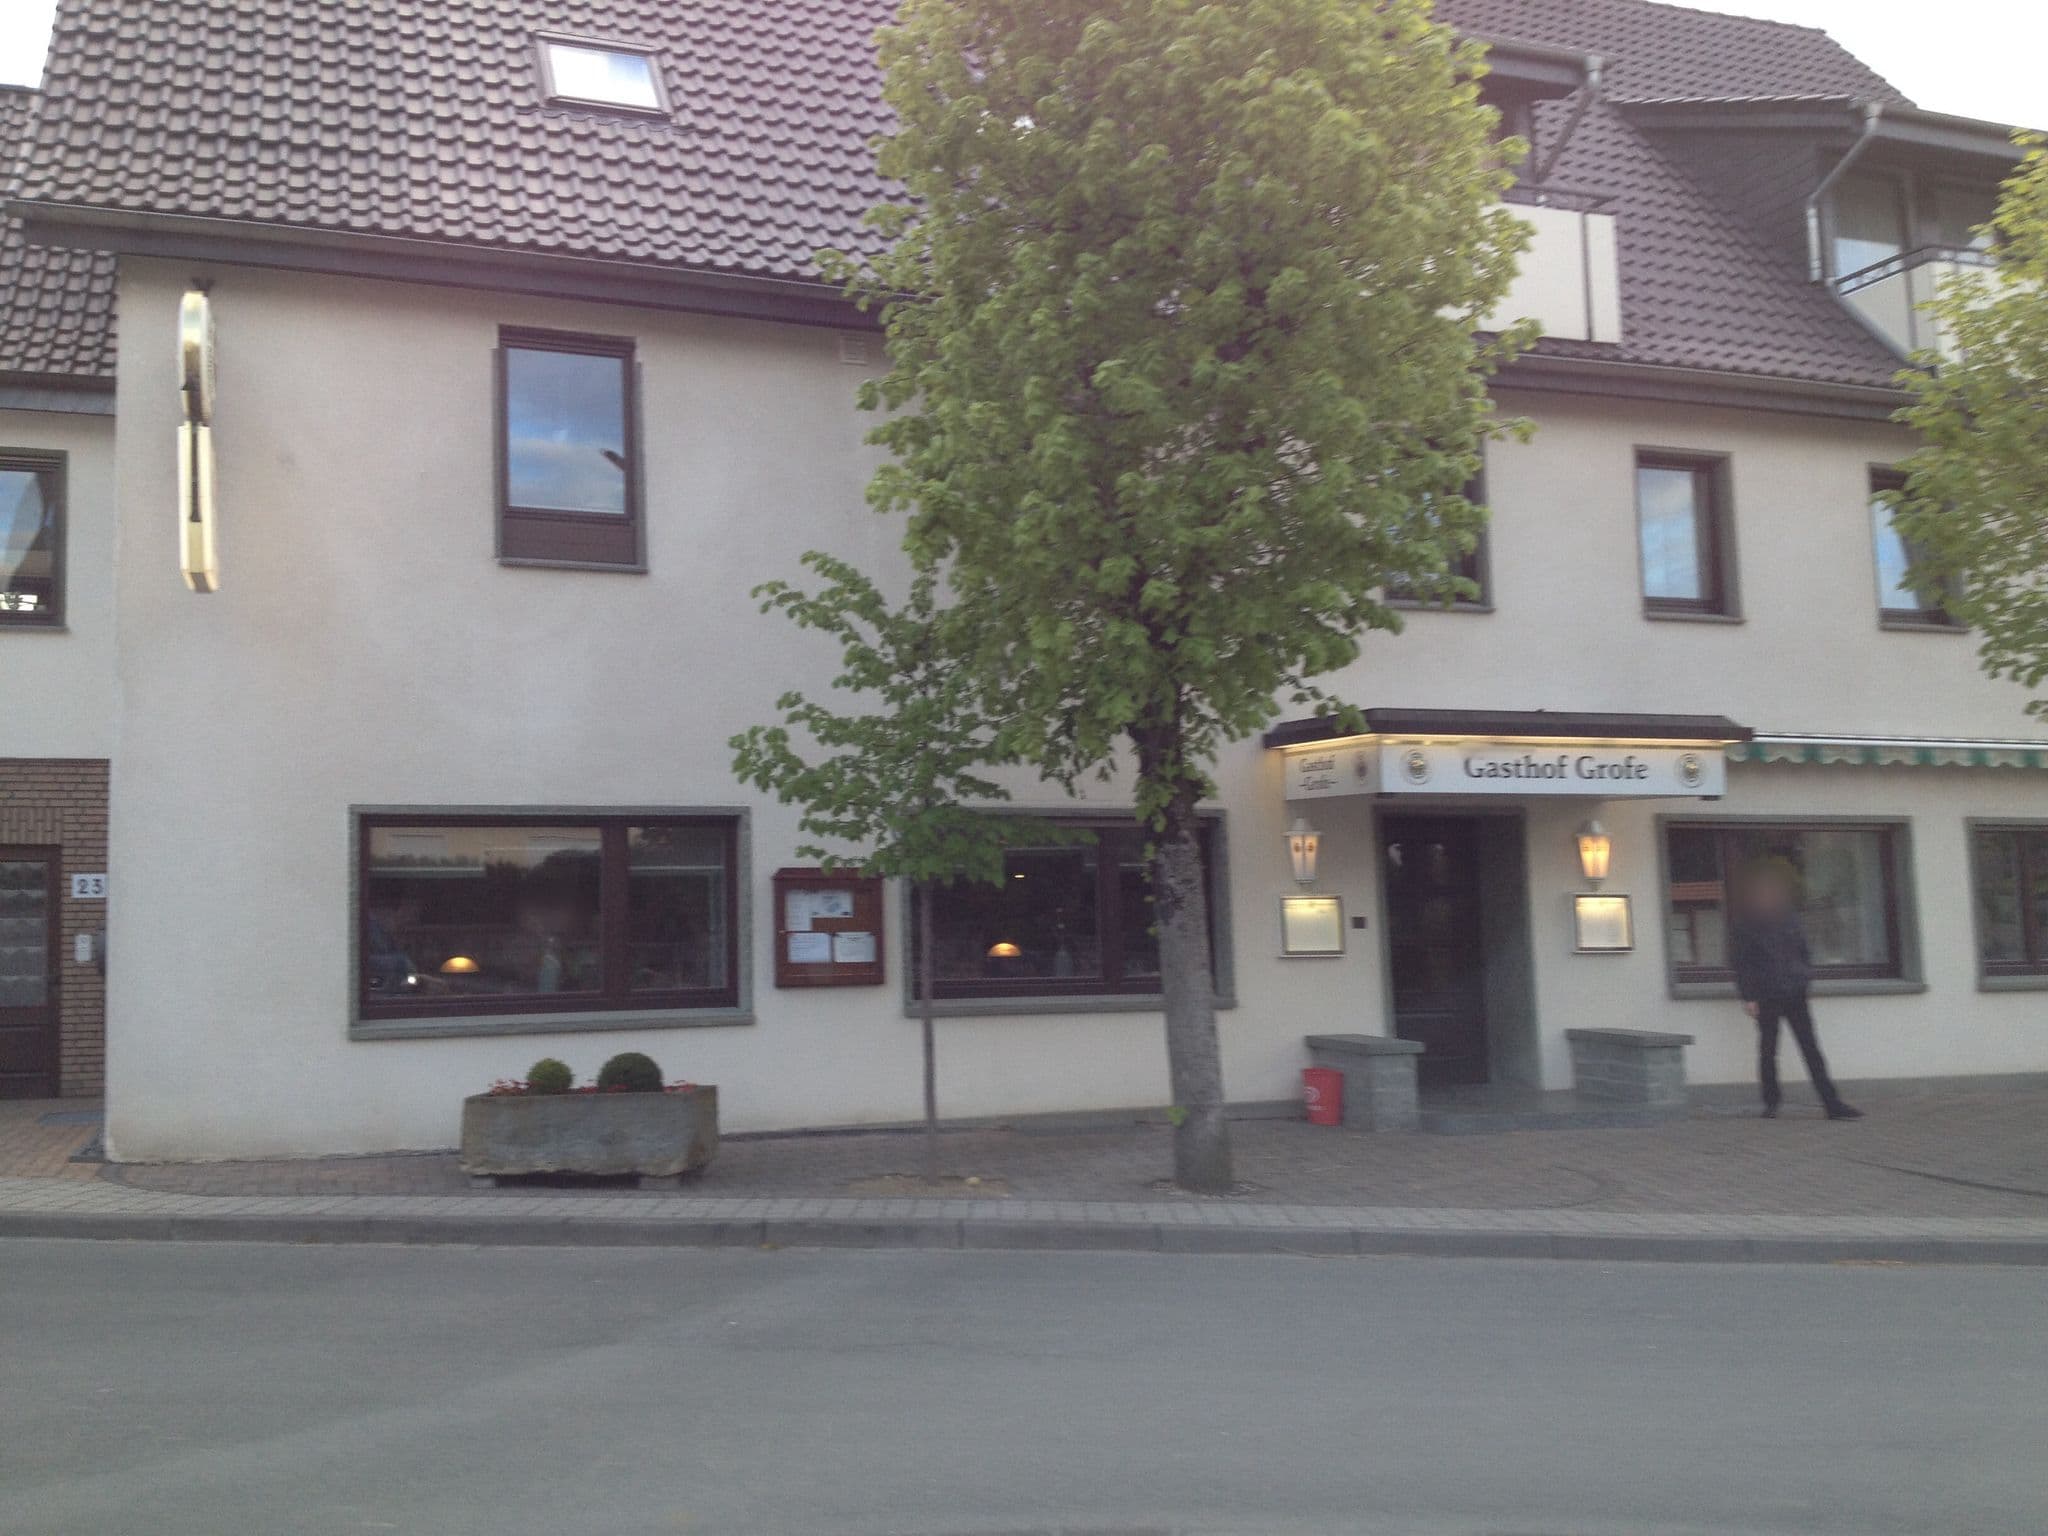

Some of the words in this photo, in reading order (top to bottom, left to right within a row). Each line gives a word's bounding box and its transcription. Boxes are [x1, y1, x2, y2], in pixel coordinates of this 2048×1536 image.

[1463, 754, 1569, 779] Gasthof
[1575, 755, 1649, 780] Grofe
[77, 878, 104, 895] 23
